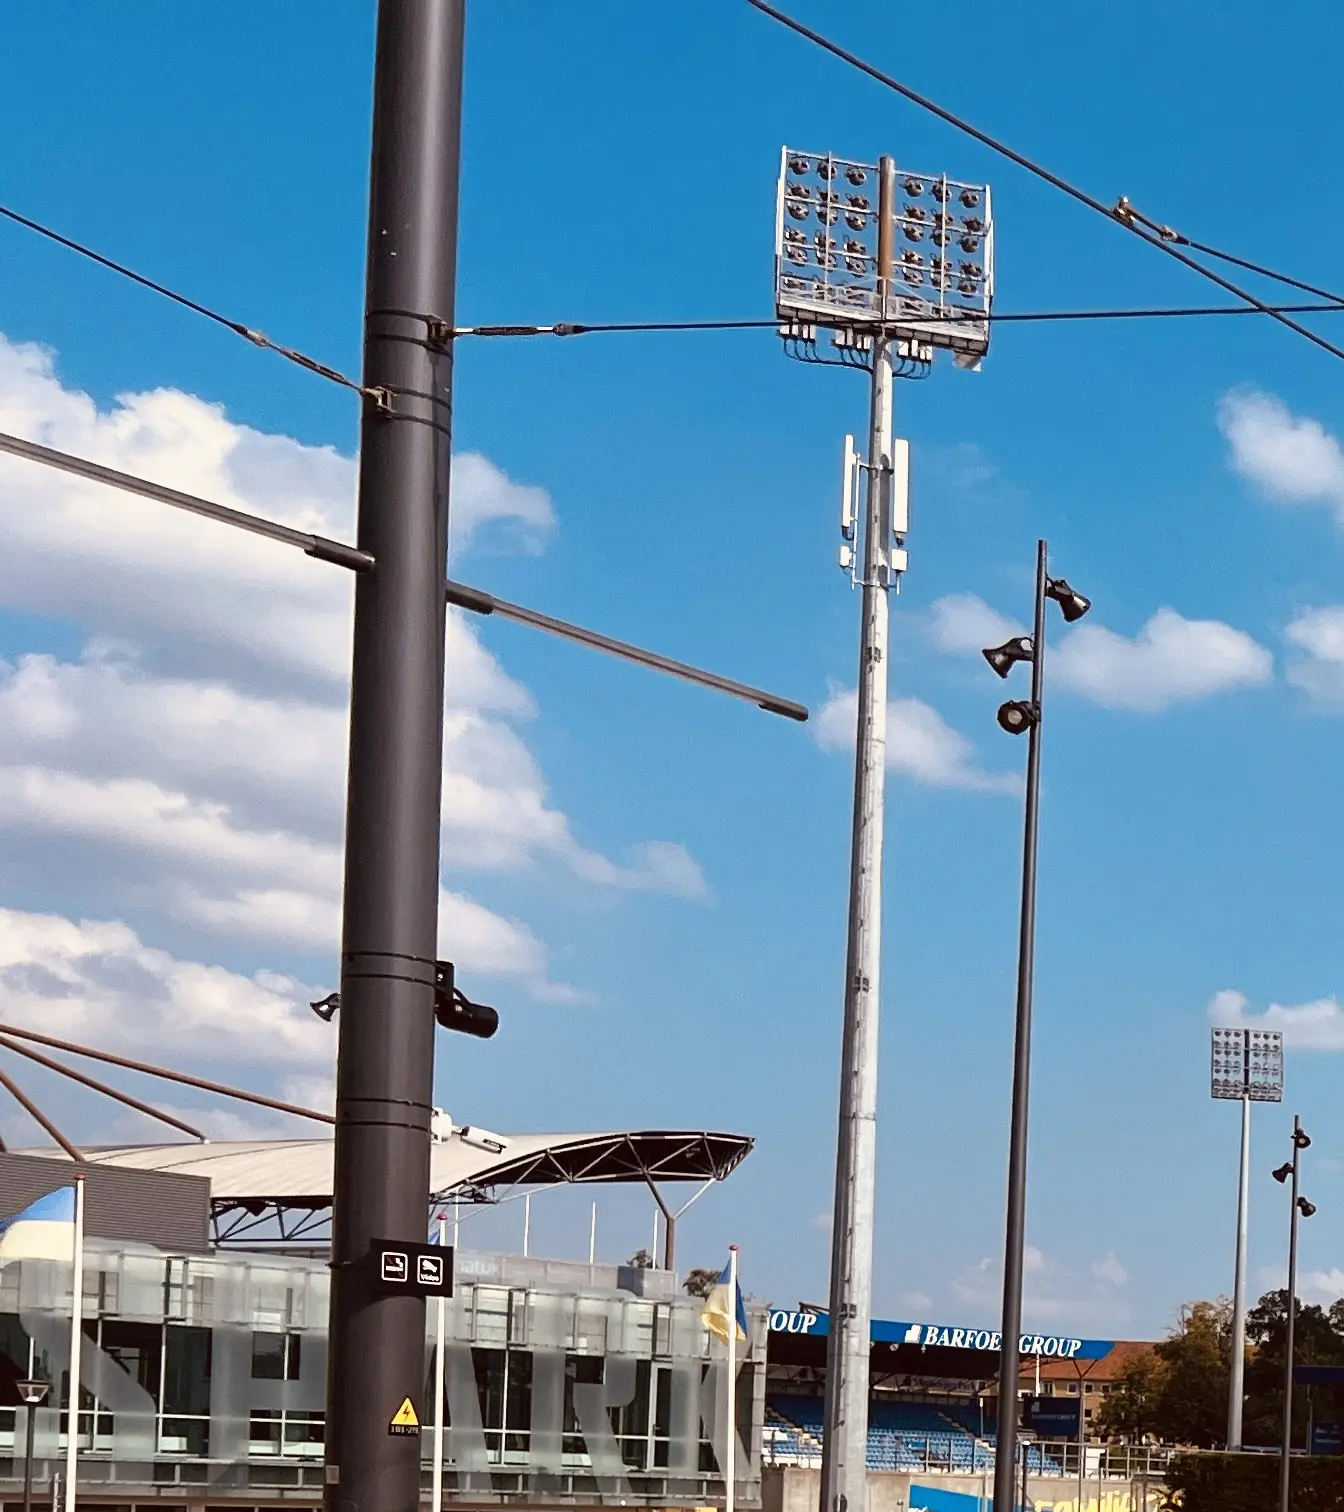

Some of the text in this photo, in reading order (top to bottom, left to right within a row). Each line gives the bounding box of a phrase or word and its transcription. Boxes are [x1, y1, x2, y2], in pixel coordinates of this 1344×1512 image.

[767, 1310, 817, 1334] OUP
[924, 1325, 1082, 1358] BARFOE GROUP
